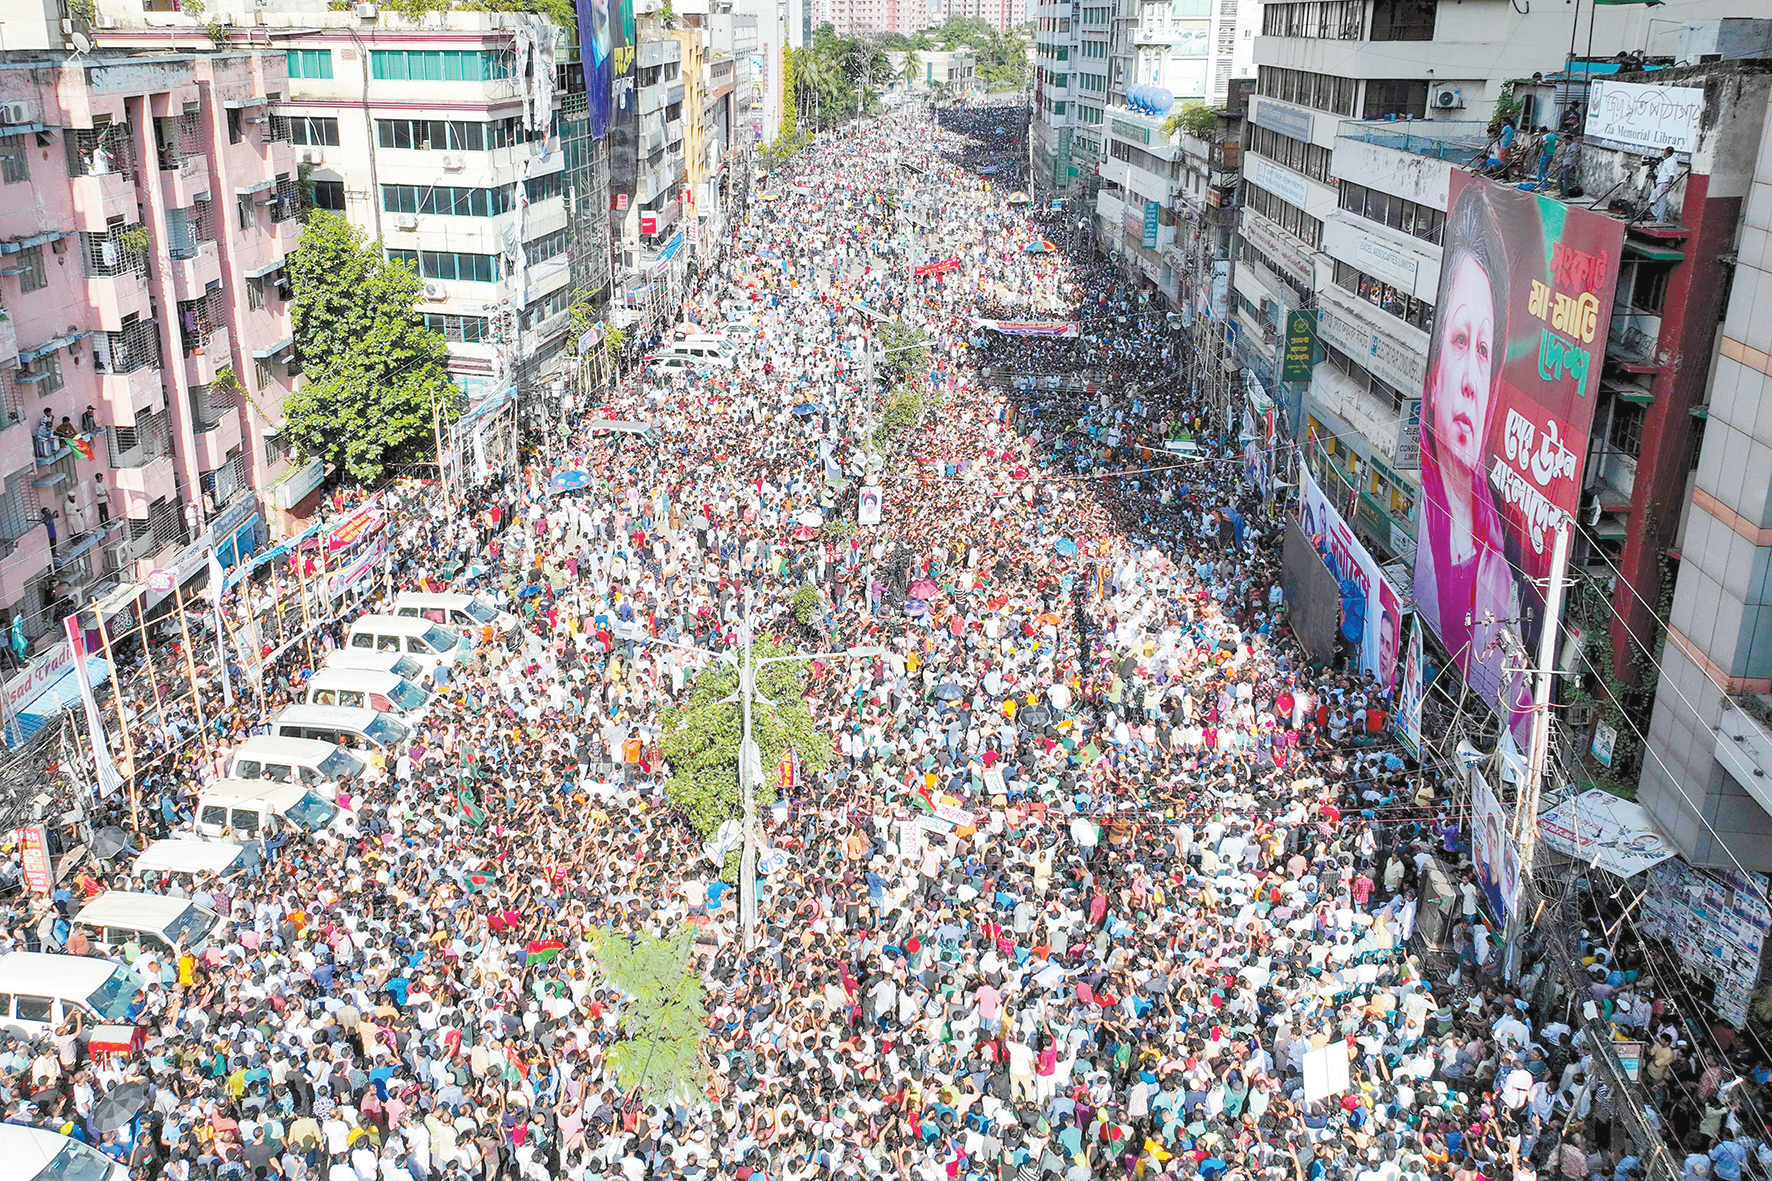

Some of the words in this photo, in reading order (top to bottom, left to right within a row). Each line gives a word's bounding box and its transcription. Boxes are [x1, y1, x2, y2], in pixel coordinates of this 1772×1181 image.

[1604, 123, 1614, 135] Zia
[1617, 124, 1651, 142] Memorial
[1653, 129, 1687, 150] Library
[1404, 453, 1421, 461] LIMITE
